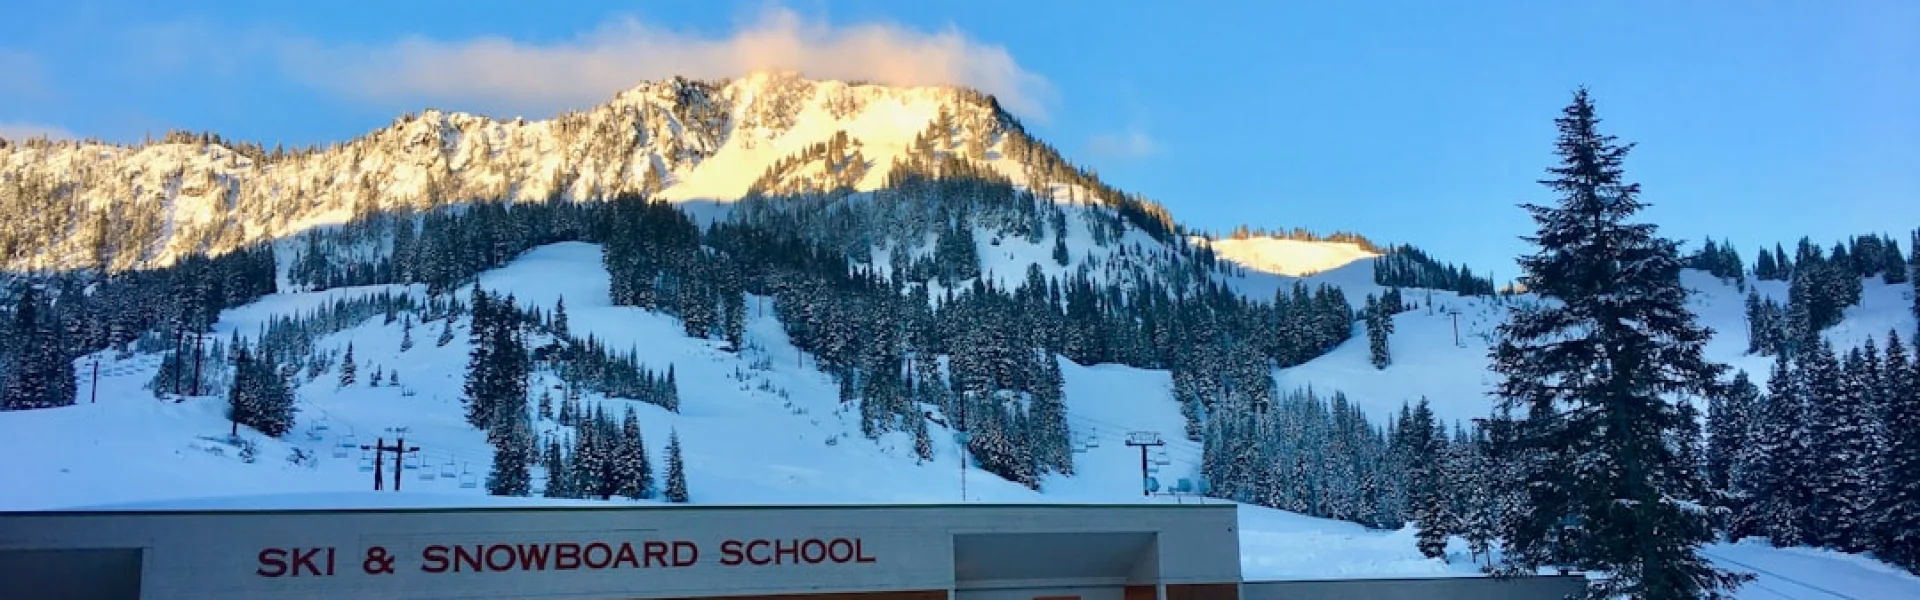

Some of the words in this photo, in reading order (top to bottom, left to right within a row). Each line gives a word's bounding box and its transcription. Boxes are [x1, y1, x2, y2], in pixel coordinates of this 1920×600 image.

[257, 548, 335, 577] SKI
[363, 546, 395, 574] &
[421, 541, 698, 573] SNOWBOARD
[720, 537, 876, 566] SCHOOL
